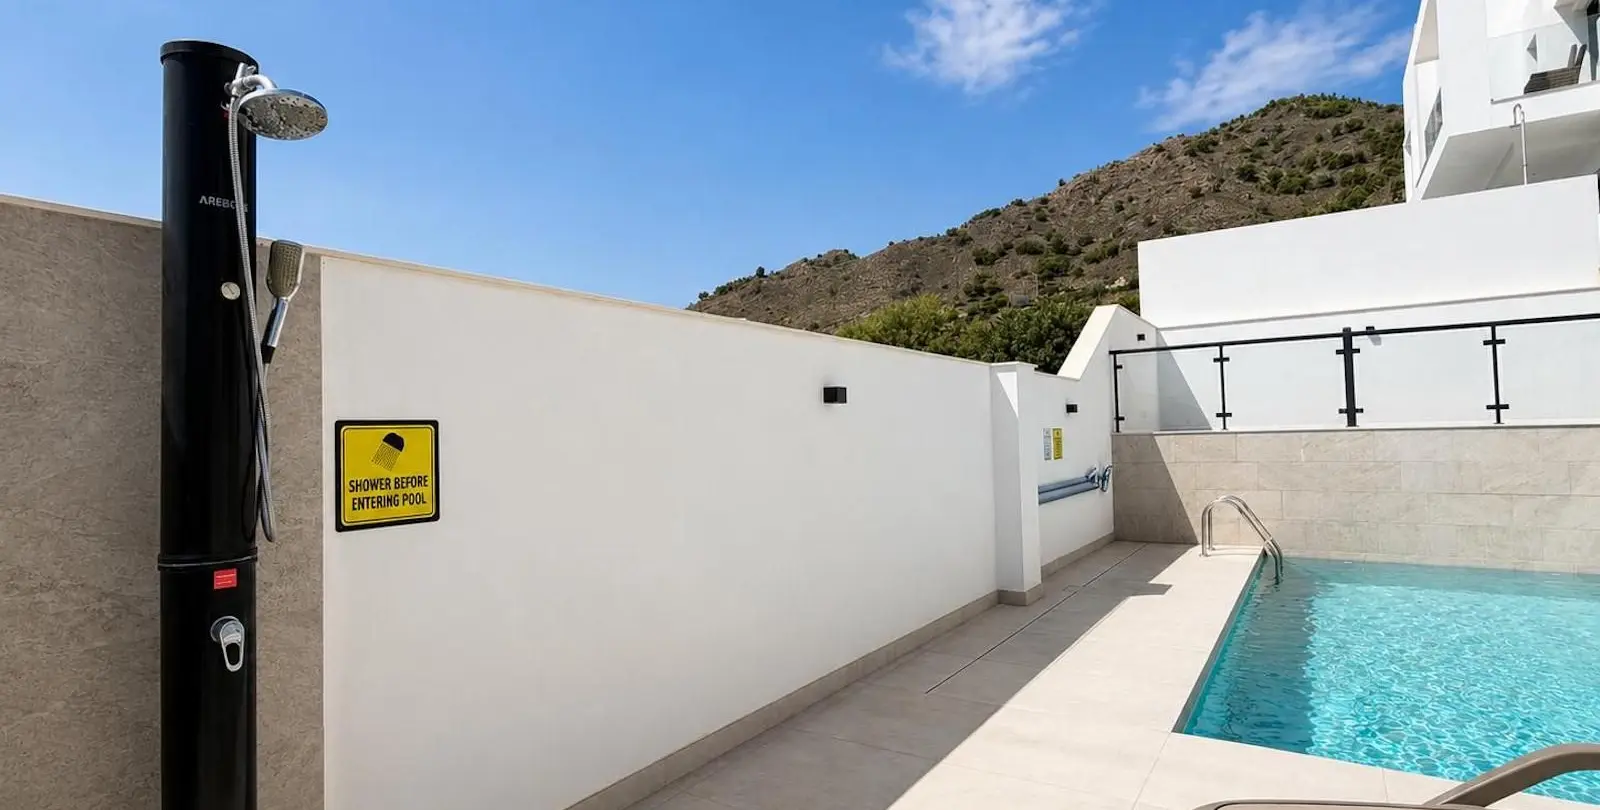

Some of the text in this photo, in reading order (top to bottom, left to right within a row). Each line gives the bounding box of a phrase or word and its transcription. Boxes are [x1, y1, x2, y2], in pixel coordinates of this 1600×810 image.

[349, 475, 428, 492] SHOWER BEFORE
[352, 492, 427, 511] ENTERING POOL
